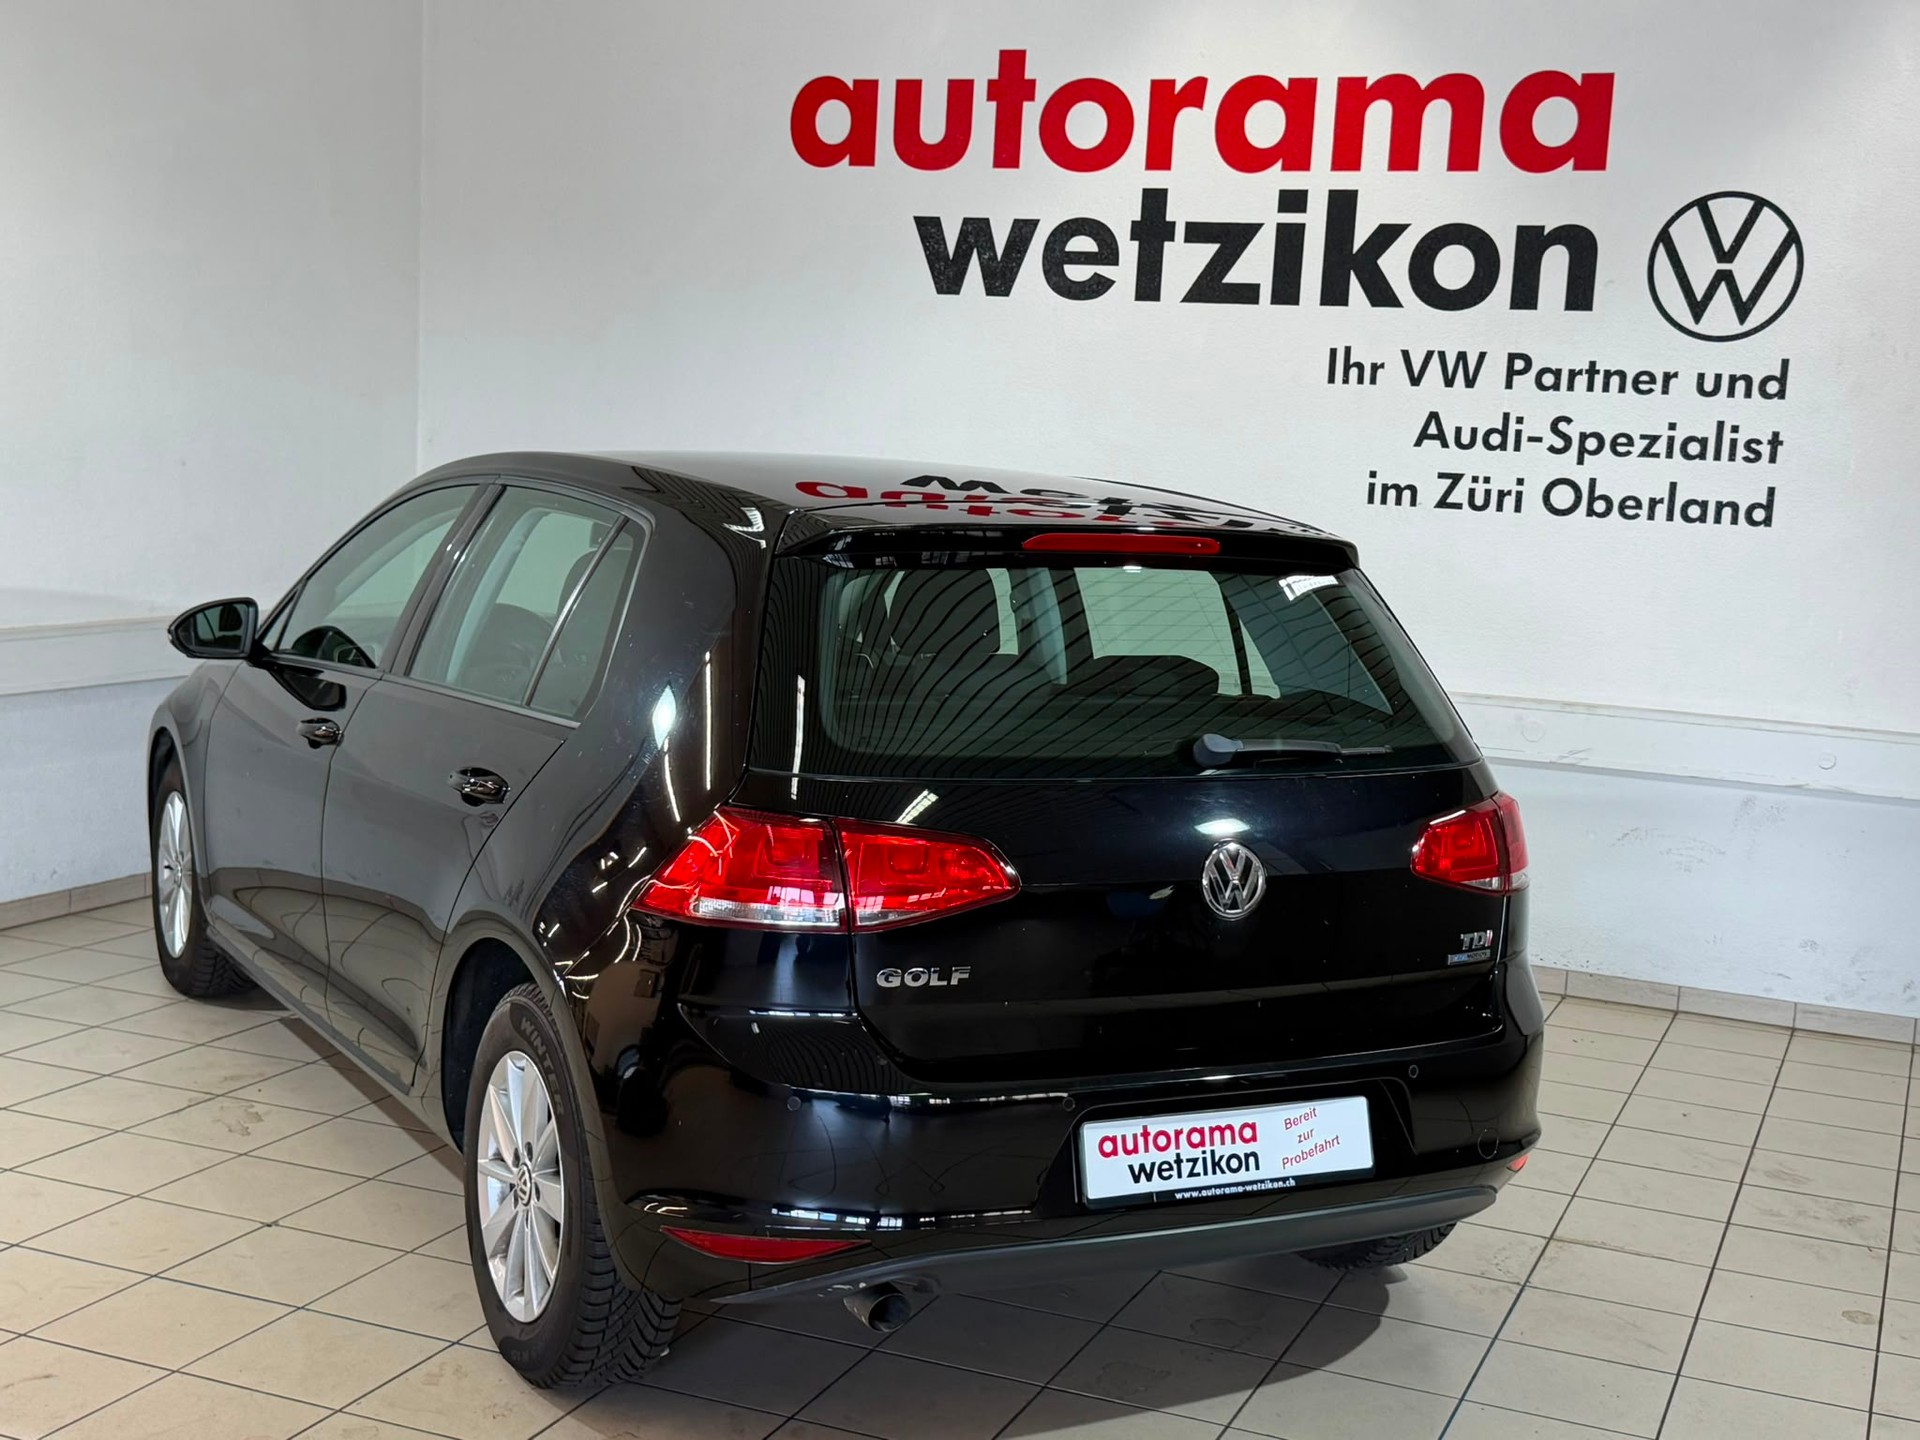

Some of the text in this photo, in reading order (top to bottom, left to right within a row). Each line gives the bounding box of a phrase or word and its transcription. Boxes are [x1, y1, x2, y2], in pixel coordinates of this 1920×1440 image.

[791, 50, 1615, 173] autorama
[913, 188, 1599, 312] wetzikon
[1647, 191, 1804, 342] VW
[1328, 345, 1790, 400] Ihr VW Partner und
[1414, 411, 1784, 466] Audi-Spezialist
[1367, 471, 1776, 528] im Züri Oberland
[1460, 929, 1494, 950] TDI
[876, 966, 972, 988] GOLF
[519, 1016, 565, 1116] WINTER
[1283, 1107, 1318, 1130] Bereit
[1297, 1128, 1315, 1144] zur
[1098, 1121, 1258, 1158] autorama
[1281, 1134, 1341, 1169] Probefahrt
[1127, 1149, 1260, 1184] wetzikon
[1174, 1177, 1297, 1200] www.autorama-wetzikon.ch
